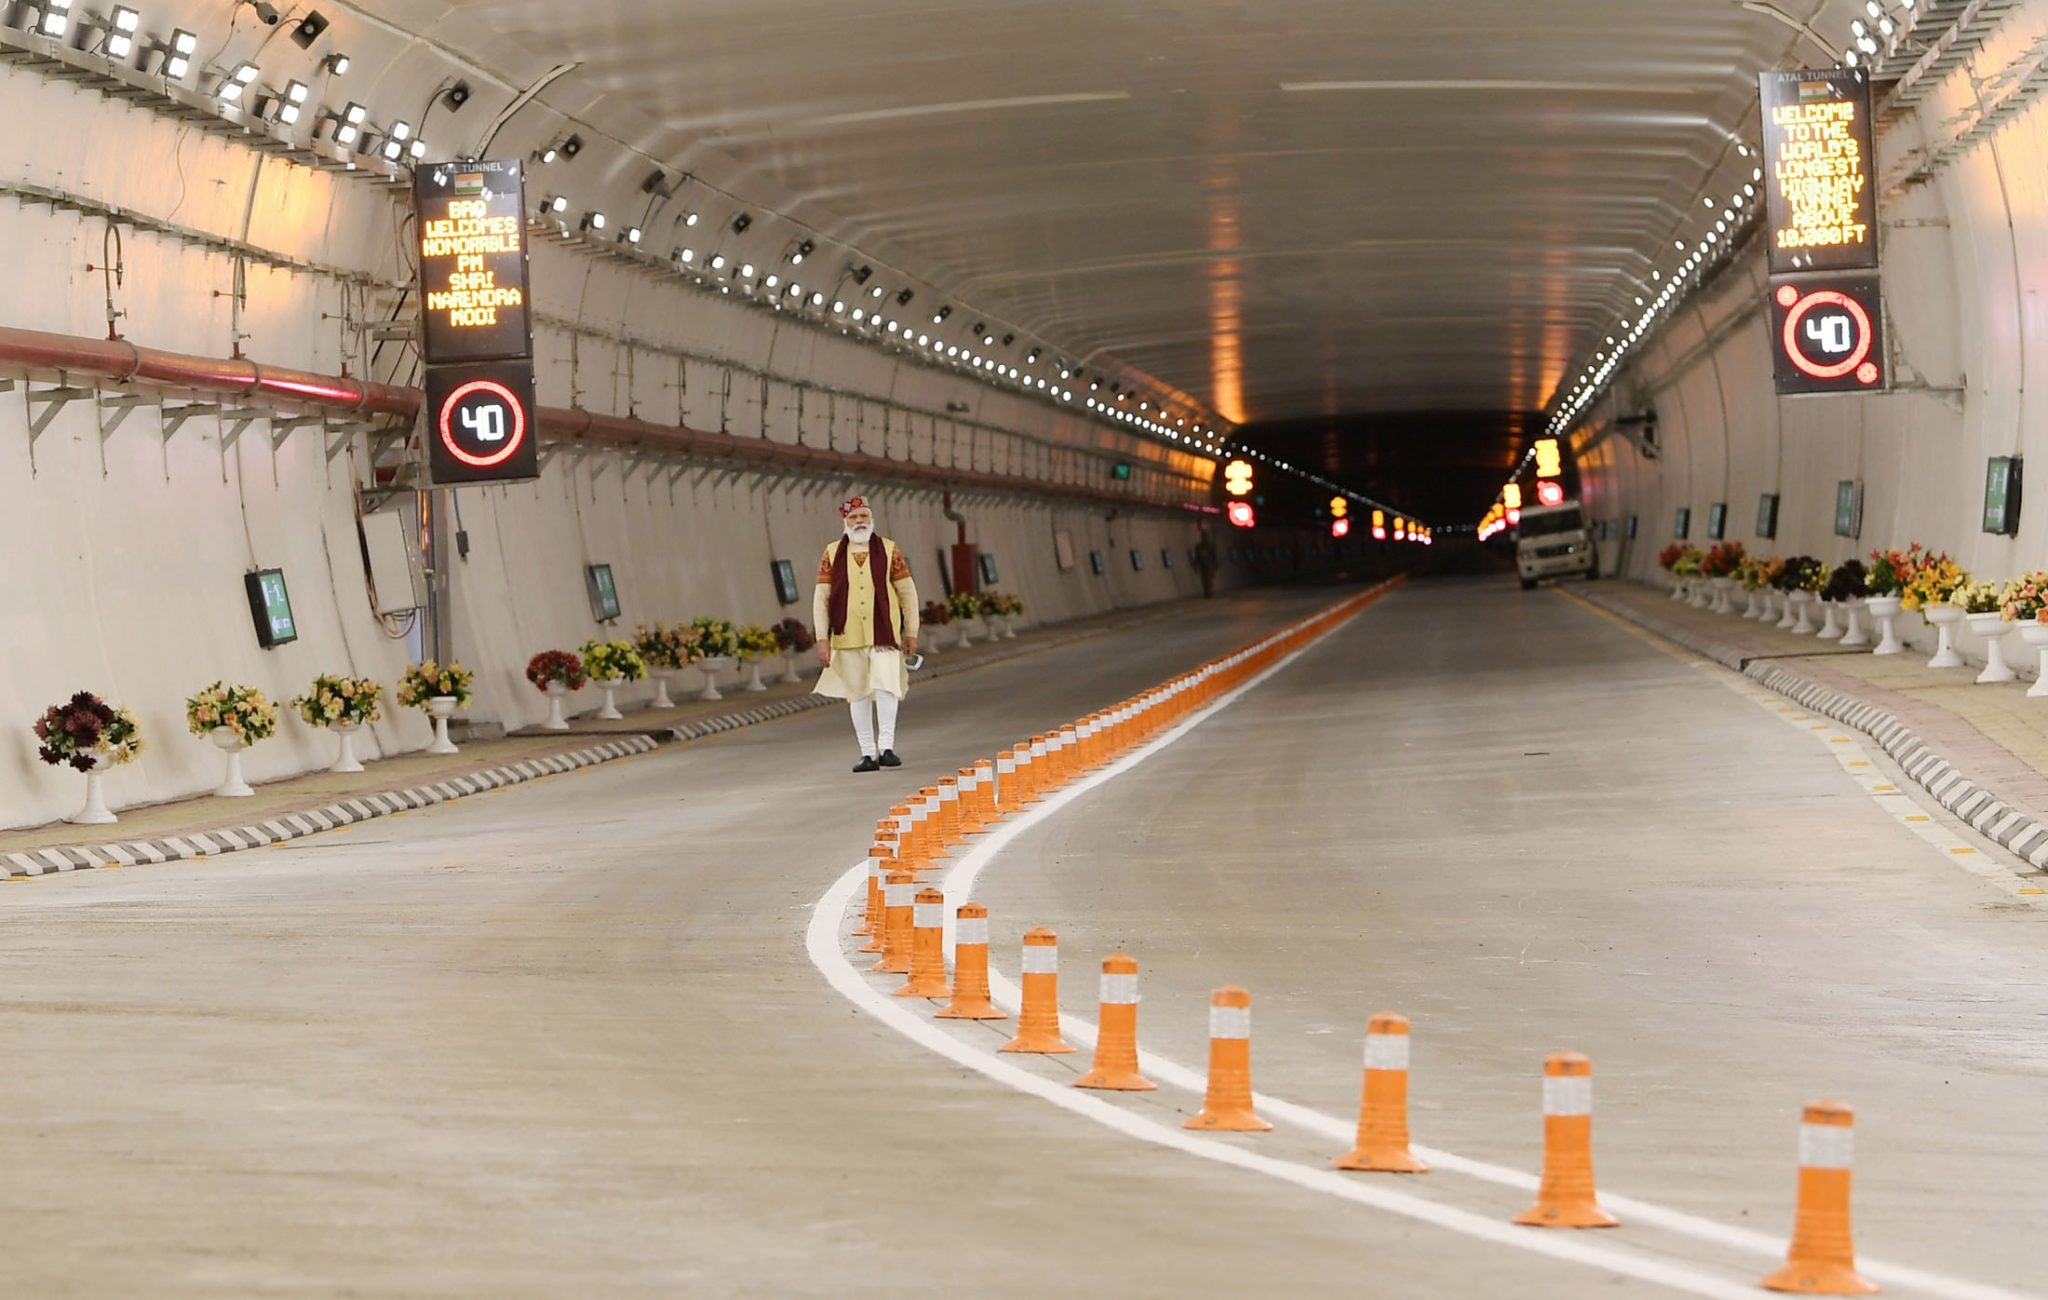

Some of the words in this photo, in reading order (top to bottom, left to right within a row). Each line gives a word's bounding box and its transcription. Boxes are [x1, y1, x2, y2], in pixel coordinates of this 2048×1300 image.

[1778, 73, 1804, 82] ATAL
[1807, 71, 1849, 80] TUNNEL
[1772, 101, 1854, 125] WELCOME
[1784, 123, 1810, 141] TO
[1811, 121, 1849, 140] THE
[1780, 139, 1858, 161] WORLD'S
[462, 162, 503, 172] TUNNEL
[1775, 156, 1860, 180] LONGEST
[1780, 174, 1864, 197] HIGHWAY
[448, 200, 487, 219] BRO
[1788, 193, 1859, 212] TUNNEL
[425, 216, 518, 239] WELCOMES
[1792, 209, 1853, 228] ABOVE
[422, 234, 521, 257] HONORABLE
[458, 254, 484, 272] PM
[449, 271, 495, 290] SHRI
[427, 288, 522, 310] NARENDRA
[451, 307, 497, 327] MODI
[1806, 315, 1851, 353] 40
[461, 404, 505, 441] 40
